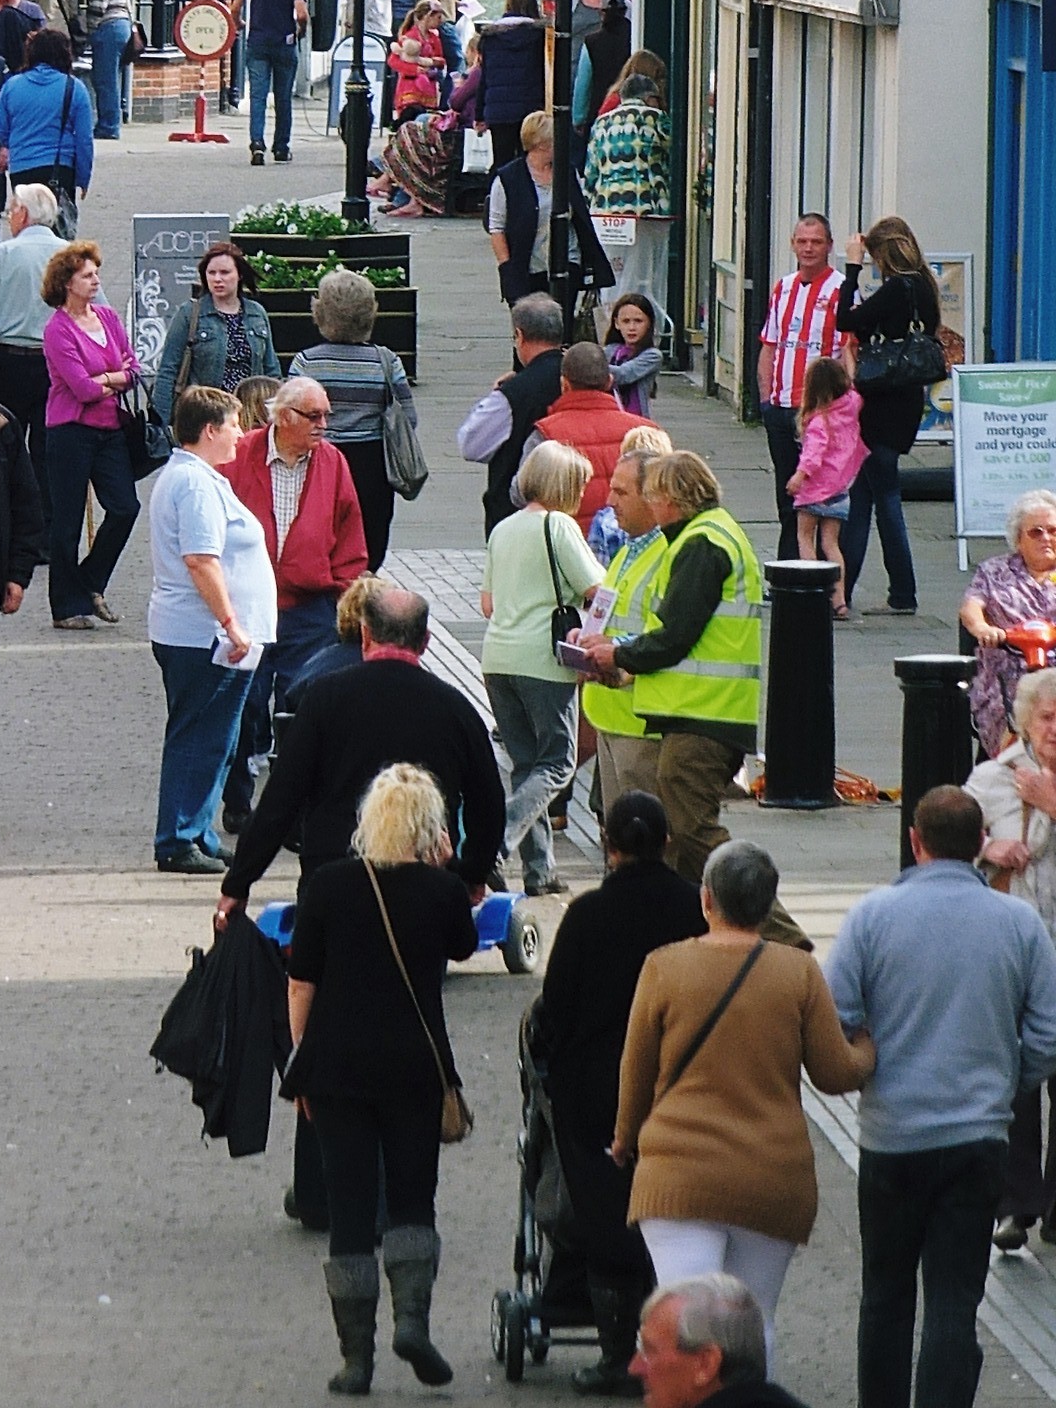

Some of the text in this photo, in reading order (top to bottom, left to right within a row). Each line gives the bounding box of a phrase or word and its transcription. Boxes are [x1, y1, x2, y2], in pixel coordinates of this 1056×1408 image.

[602, 218, 627, 227] STOP
[978, 379, 1012, 390] Switch
[998, 392, 1022, 402] Save
[984, 411, 1049, 424] Move your
[986, 426, 1047, 438] mortgage
[975, 439, 998, 450] and
[1000, 441, 1023, 452] you
[984, 454, 1011, 463] save
